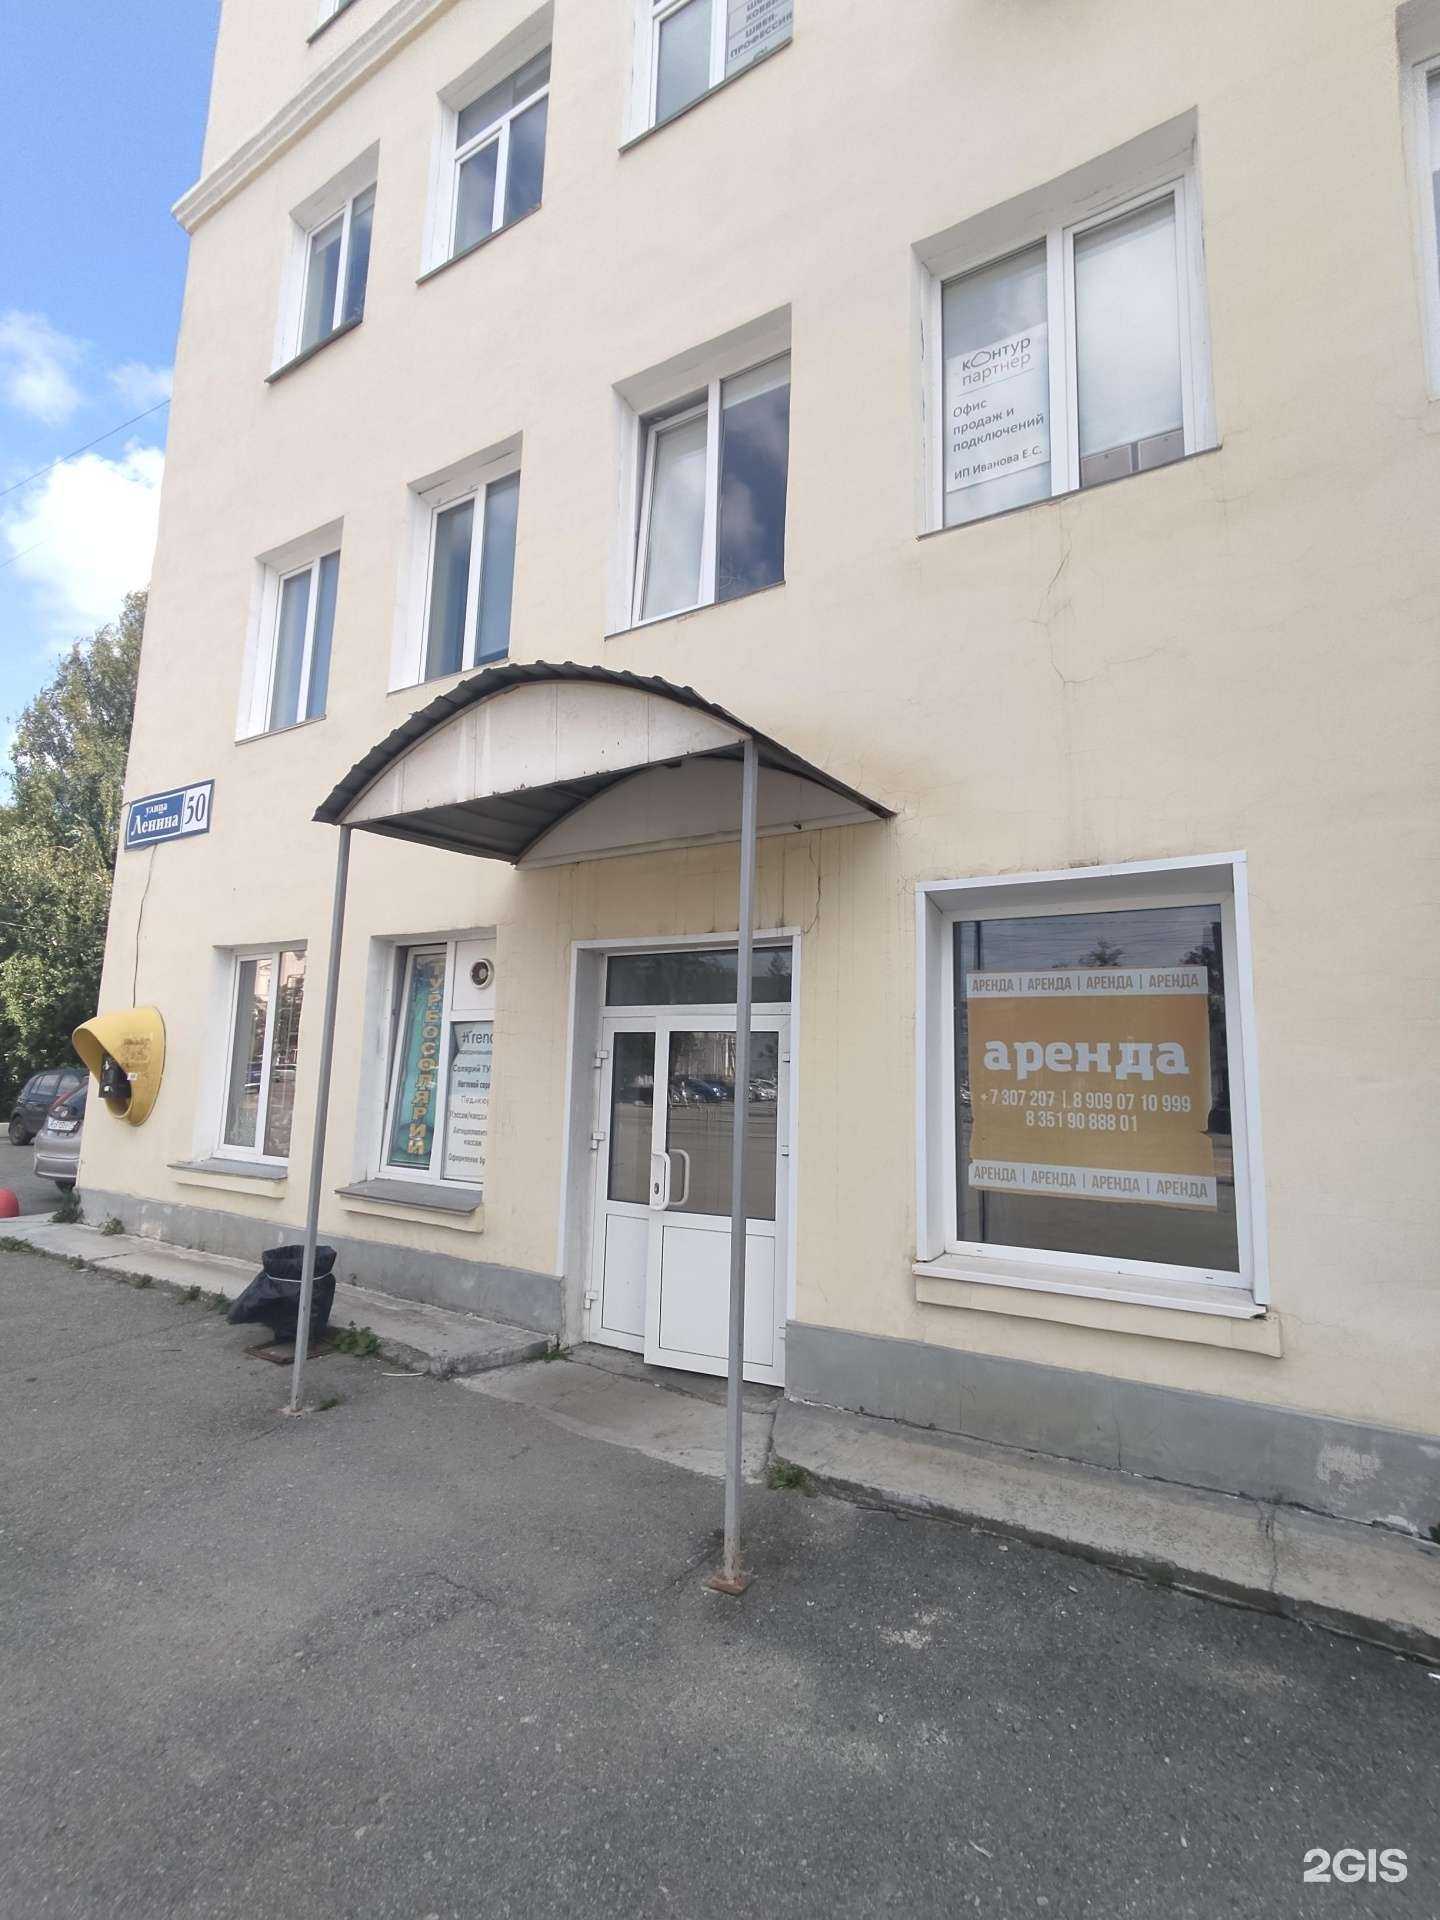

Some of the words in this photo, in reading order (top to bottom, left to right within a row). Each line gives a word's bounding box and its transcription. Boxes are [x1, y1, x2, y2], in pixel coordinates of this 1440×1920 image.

[962, 353, 1031, 386] партнер
[953, 400, 987, 418] Офис
[953, 412, 1002, 436] продаж
[1006, 407, 1015, 417] и
[953, 413, 1045, 452] подключений
[954, 467, 970, 480] ИП
[972, 453, 1019, 475] Иванова
[144, 803, 168, 818] улица
[185, 793, 206, 825] 50
[131, 814, 179, 836] Ленина
[972, 978, 1014, 992] АРЕНДА
[1027, 976, 1072, 991] АРЕНДА
[1086, 975, 1134, 990] АРЕНДА
[1149, 974, 1199, 988] АРЕНДА
[983, 1040, 1190, 1081] аренда
[1000, 1090, 1026, 1106] 307
[1030, 1091, 1055, 1107] 207
[1072, 1092, 1083, 1108] 8
[1086, 1093, 1113, 1110] 909
[1117, 1094, 1135, 1111] 07
[1141, 1095, 1158, 1112] 10
[1162, 1095, 1191, 1113] 999
[1026, 1110, 1035, 1127] 8
[1038, 1111, 1063, 1128] 351
[1067, 1112, 1085, 1129] 90
[1088, 1113, 1116, 1131] 888
[1120, 1115, 1137, 1132] 01
[973, 1166, 1017, 1183] АРЕНДА
[1031, 1170, 1077, 1188] АРЕНДА
[1092, 1175, 1140, 1192] АРЕНДА
[1156, 1180, 1208, 1198] АРЕНДА
